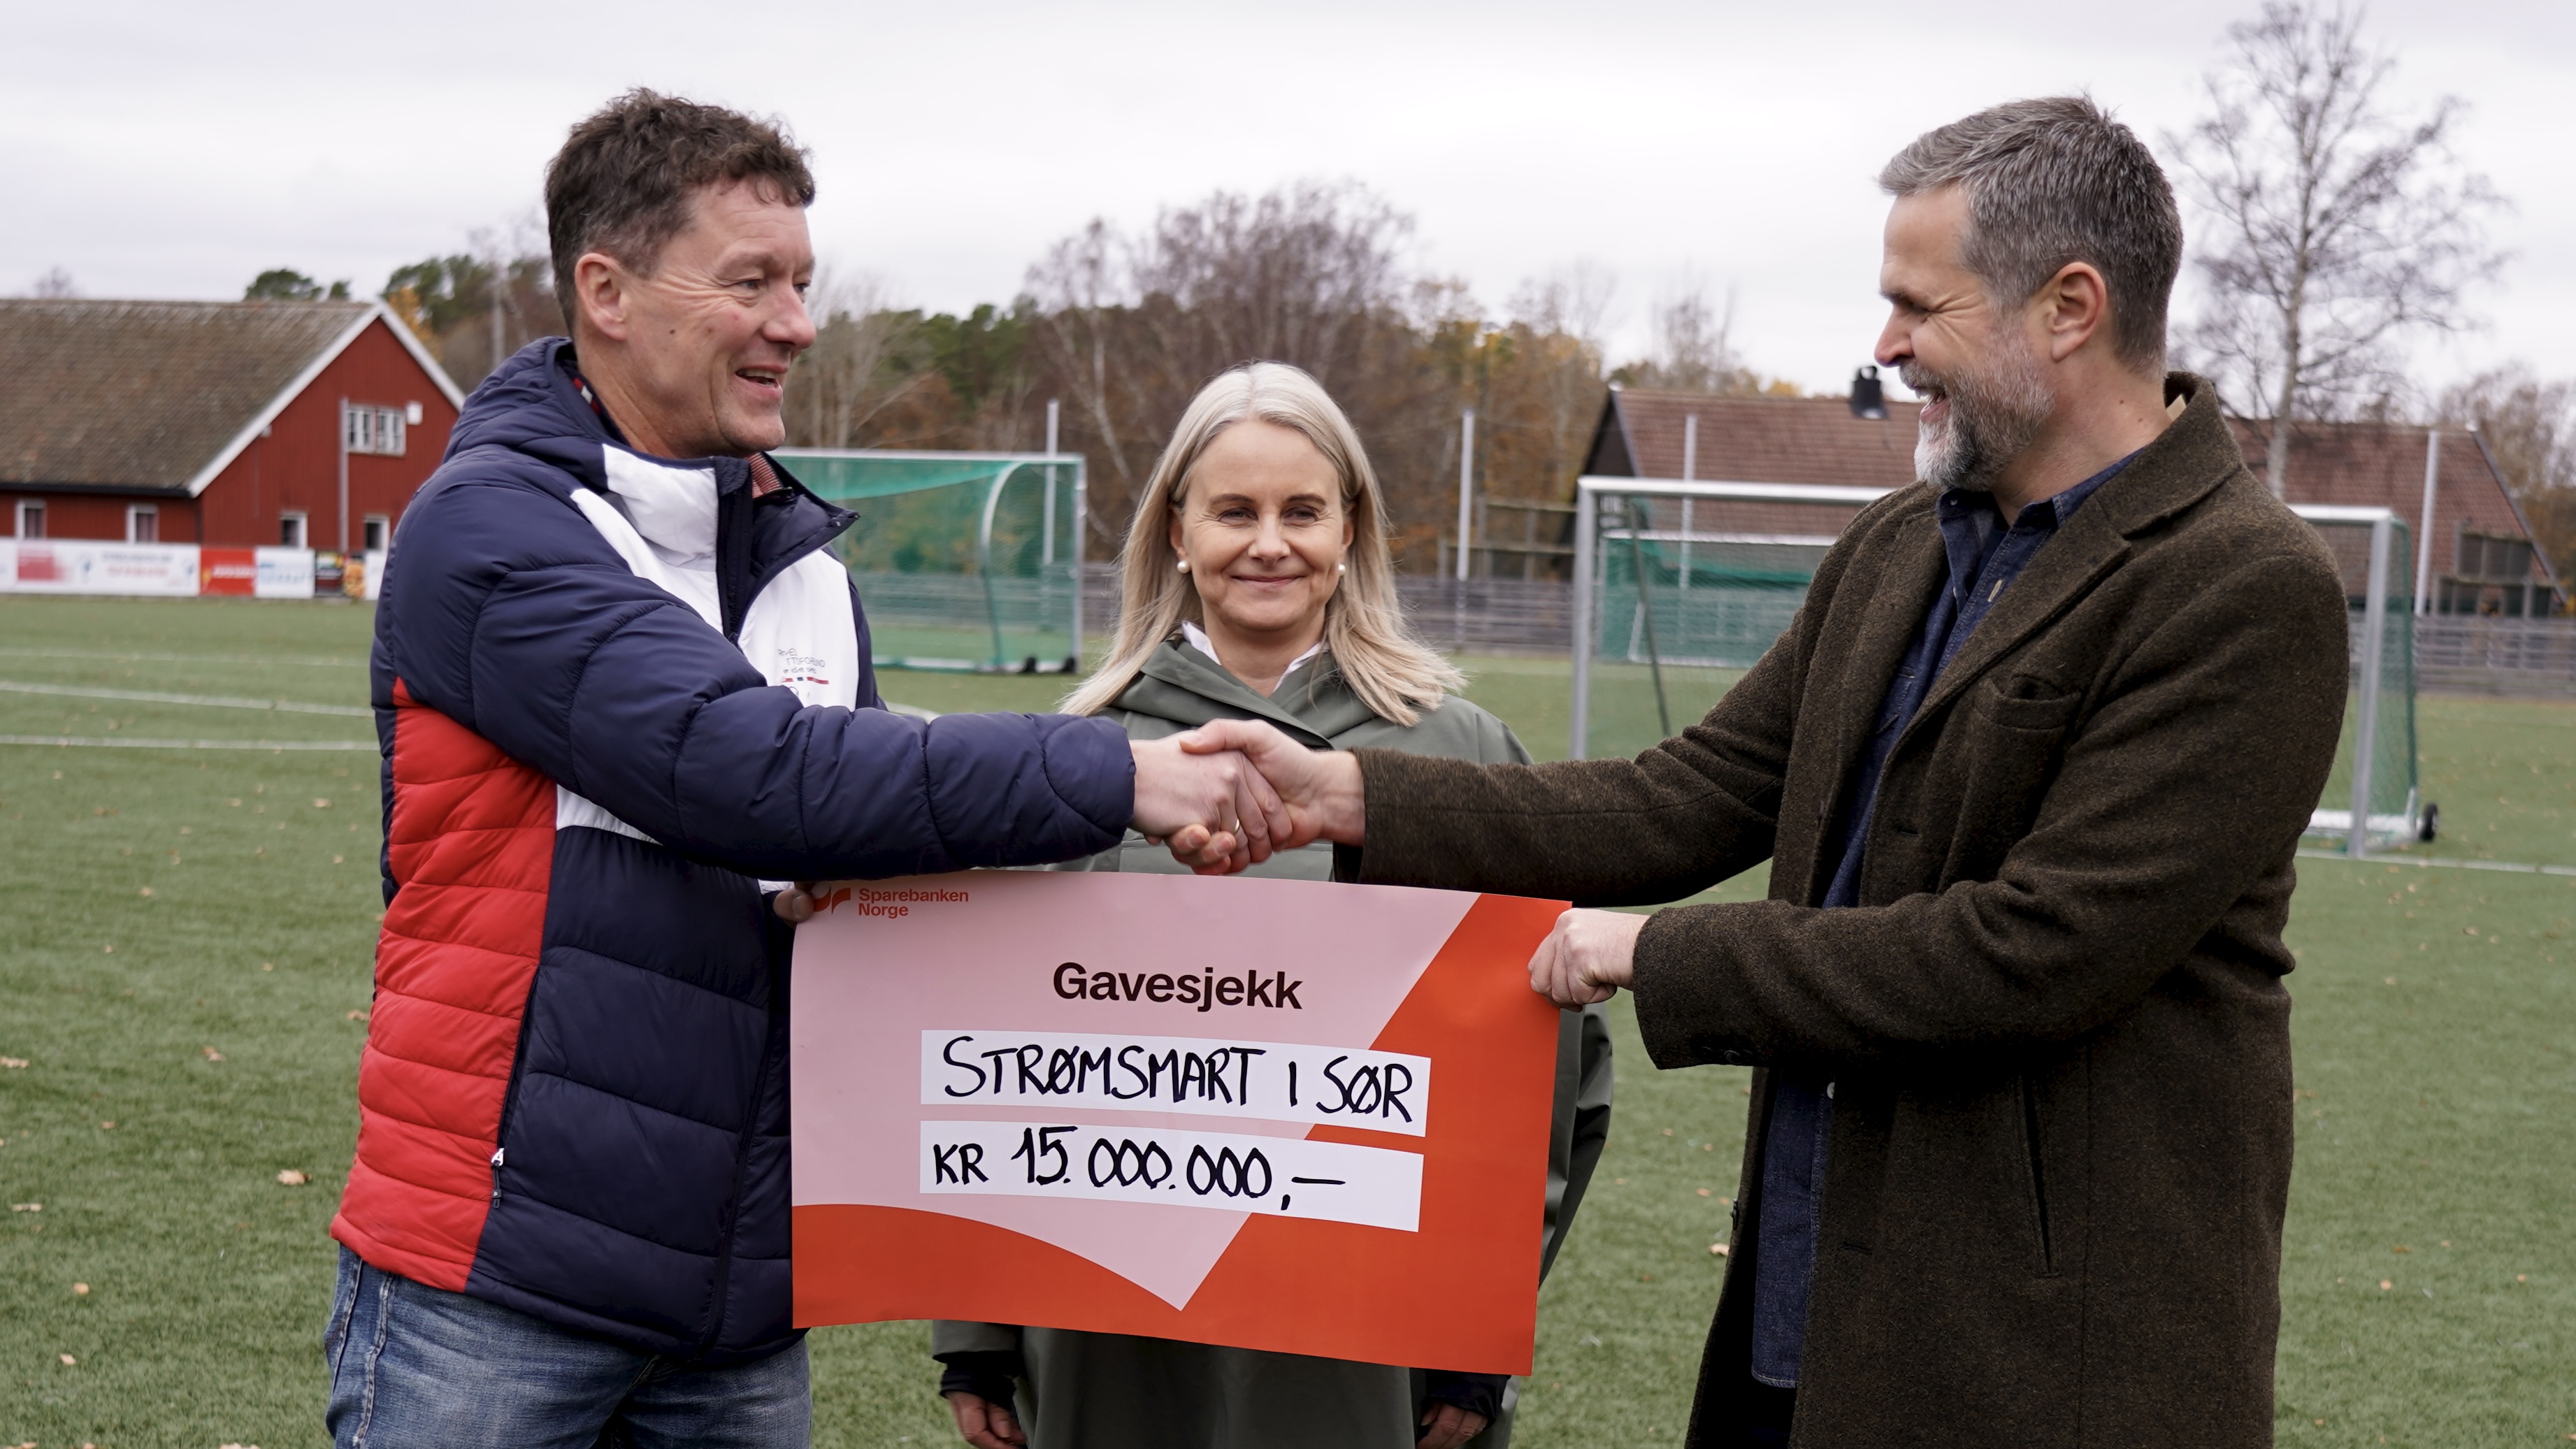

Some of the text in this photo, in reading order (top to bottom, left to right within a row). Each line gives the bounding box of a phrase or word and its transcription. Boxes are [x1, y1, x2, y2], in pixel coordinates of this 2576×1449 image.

[858, 888, 969, 904] Sparebanken
[858, 902, 909, 919] Norge
[1053, 962, 1304, 1013] Gavesjekk
[943, 1036, 1413, 1123] STRØMSMART I SØR
[933, 1144, 989, 1185] KR
